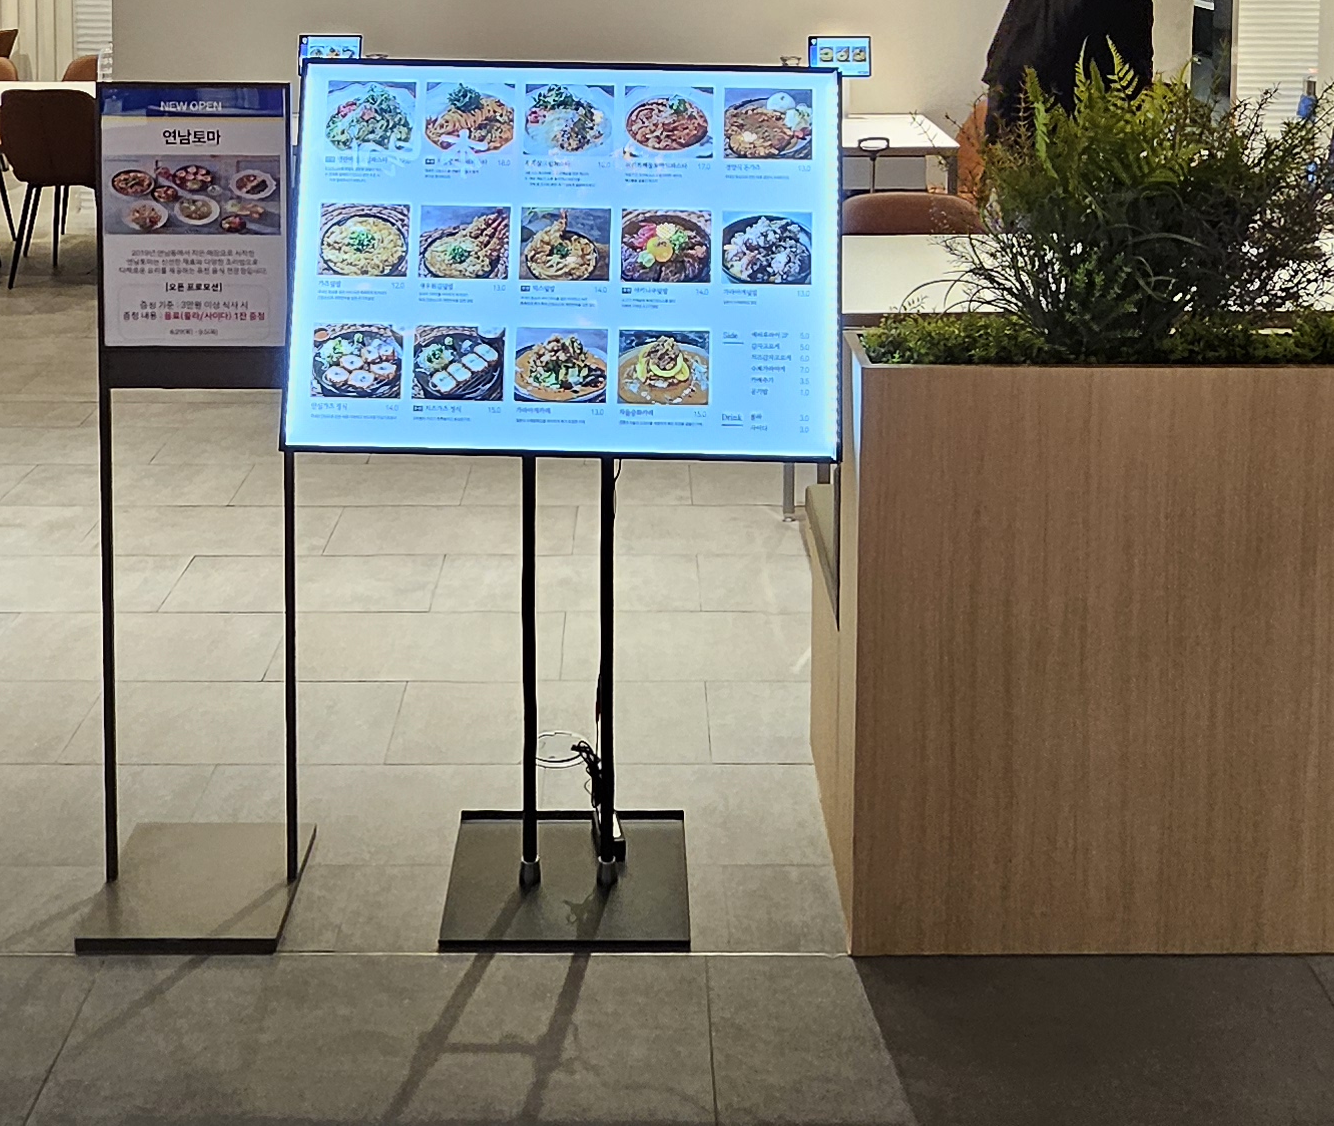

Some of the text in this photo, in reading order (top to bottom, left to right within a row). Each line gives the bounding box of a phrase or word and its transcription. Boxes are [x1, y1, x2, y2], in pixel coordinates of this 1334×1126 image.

[160, 101, 222, 111] NEW OPEN
[162, 129, 221, 145] 연남토마
